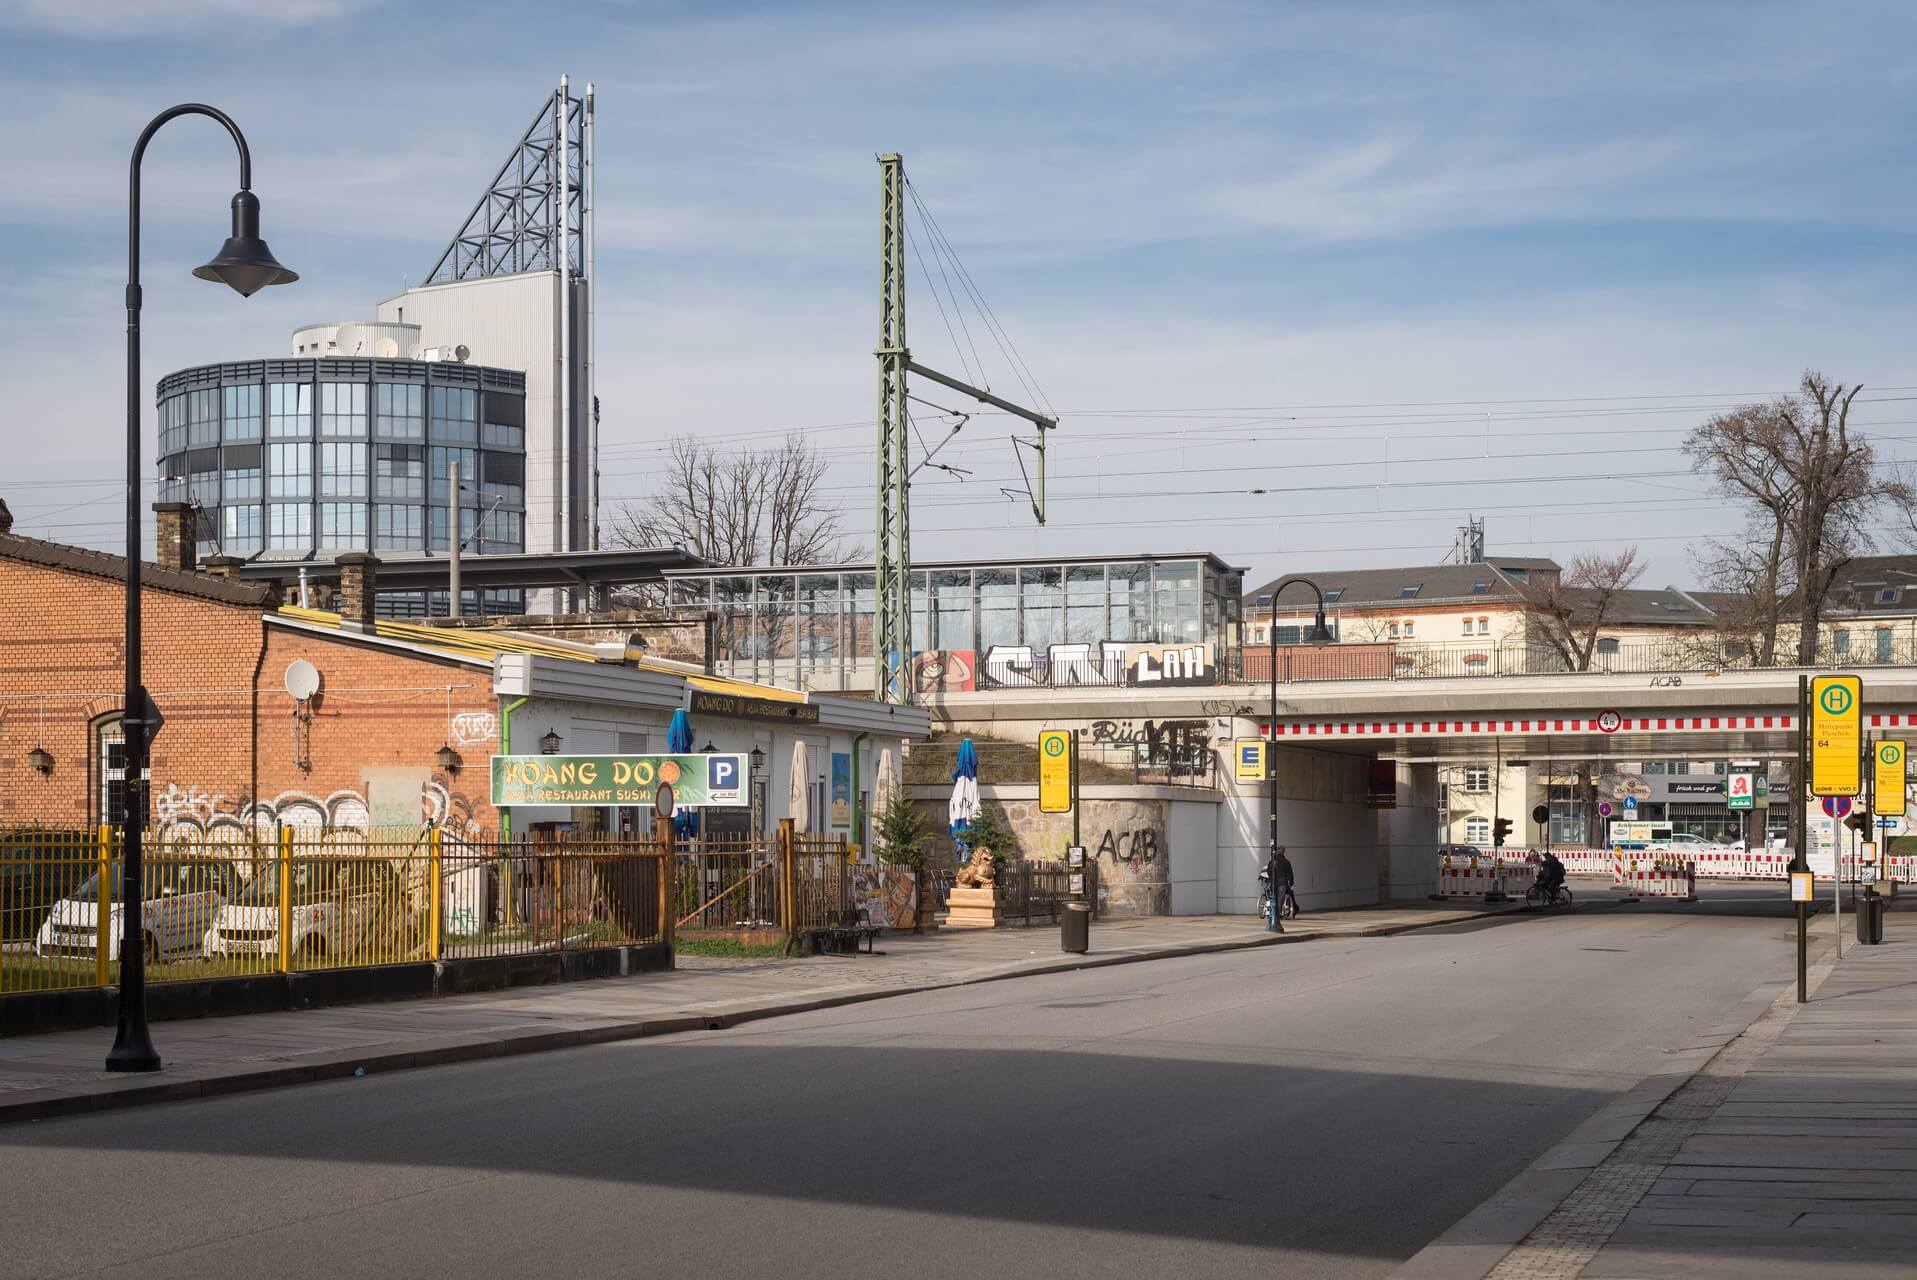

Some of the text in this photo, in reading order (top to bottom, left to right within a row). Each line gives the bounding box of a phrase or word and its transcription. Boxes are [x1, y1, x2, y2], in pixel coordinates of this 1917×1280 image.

[1650, 676, 1682, 688] ACAB
[1818, 740, 1829, 748] 64
[504, 761, 654, 785] HOANG DO
[716, 762, 732, 785] P
[538, 789, 613, 801] RESTAURANT
[616, 789, 650, 800] SUSHI
[1096, 828, 1157, 865] ACAB
